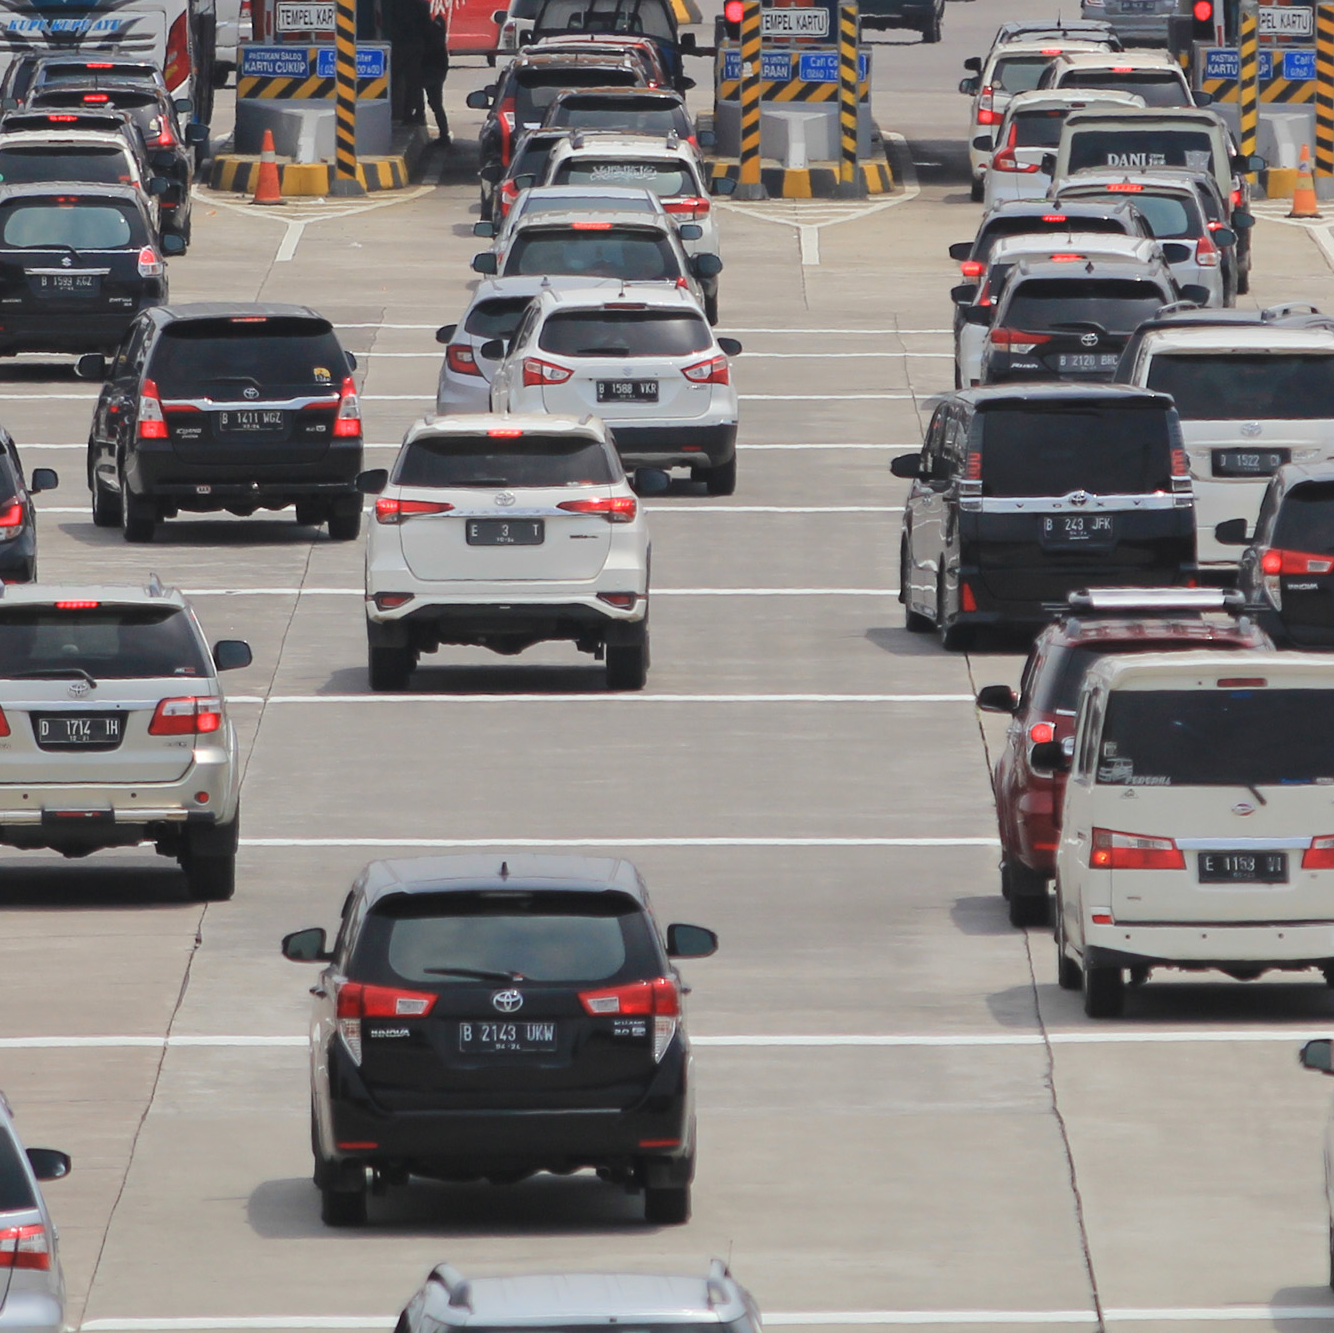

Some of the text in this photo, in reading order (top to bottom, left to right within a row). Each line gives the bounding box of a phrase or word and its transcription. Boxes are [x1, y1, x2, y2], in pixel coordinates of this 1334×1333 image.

[281, 9, 314, 25] TEMPEL
[797, 15, 825, 30] KARTU
[1279, 12, 1308, 31] KARTU
[8, 19, 122, 31] KUPU KUPU AYU
[245, 62, 306, 72] KARTU CUKUP
[810, 58, 826, 66] Call
[1208, 64, 1238, 75] KARTU
[1108, 153, 1146, 166] DANI
[41, 277, 47, 286] B
[1060, 356, 1067, 366] B
[599, 384, 605, 394] B
[612, 384, 633, 394] 1588
[222, 413, 229, 424] B
[264, 413, 281, 424] WGZ
[1237, 455, 1260, 466] 1522
[1046, 518, 1111, 531] B 243 JFK
[472, 525, 539, 537] E 3 T
[41, 721, 118, 736] D 1714 IH
[1206, 857, 1213, 871] E
[463, 1025, 554, 1041] B 2143 UKW
